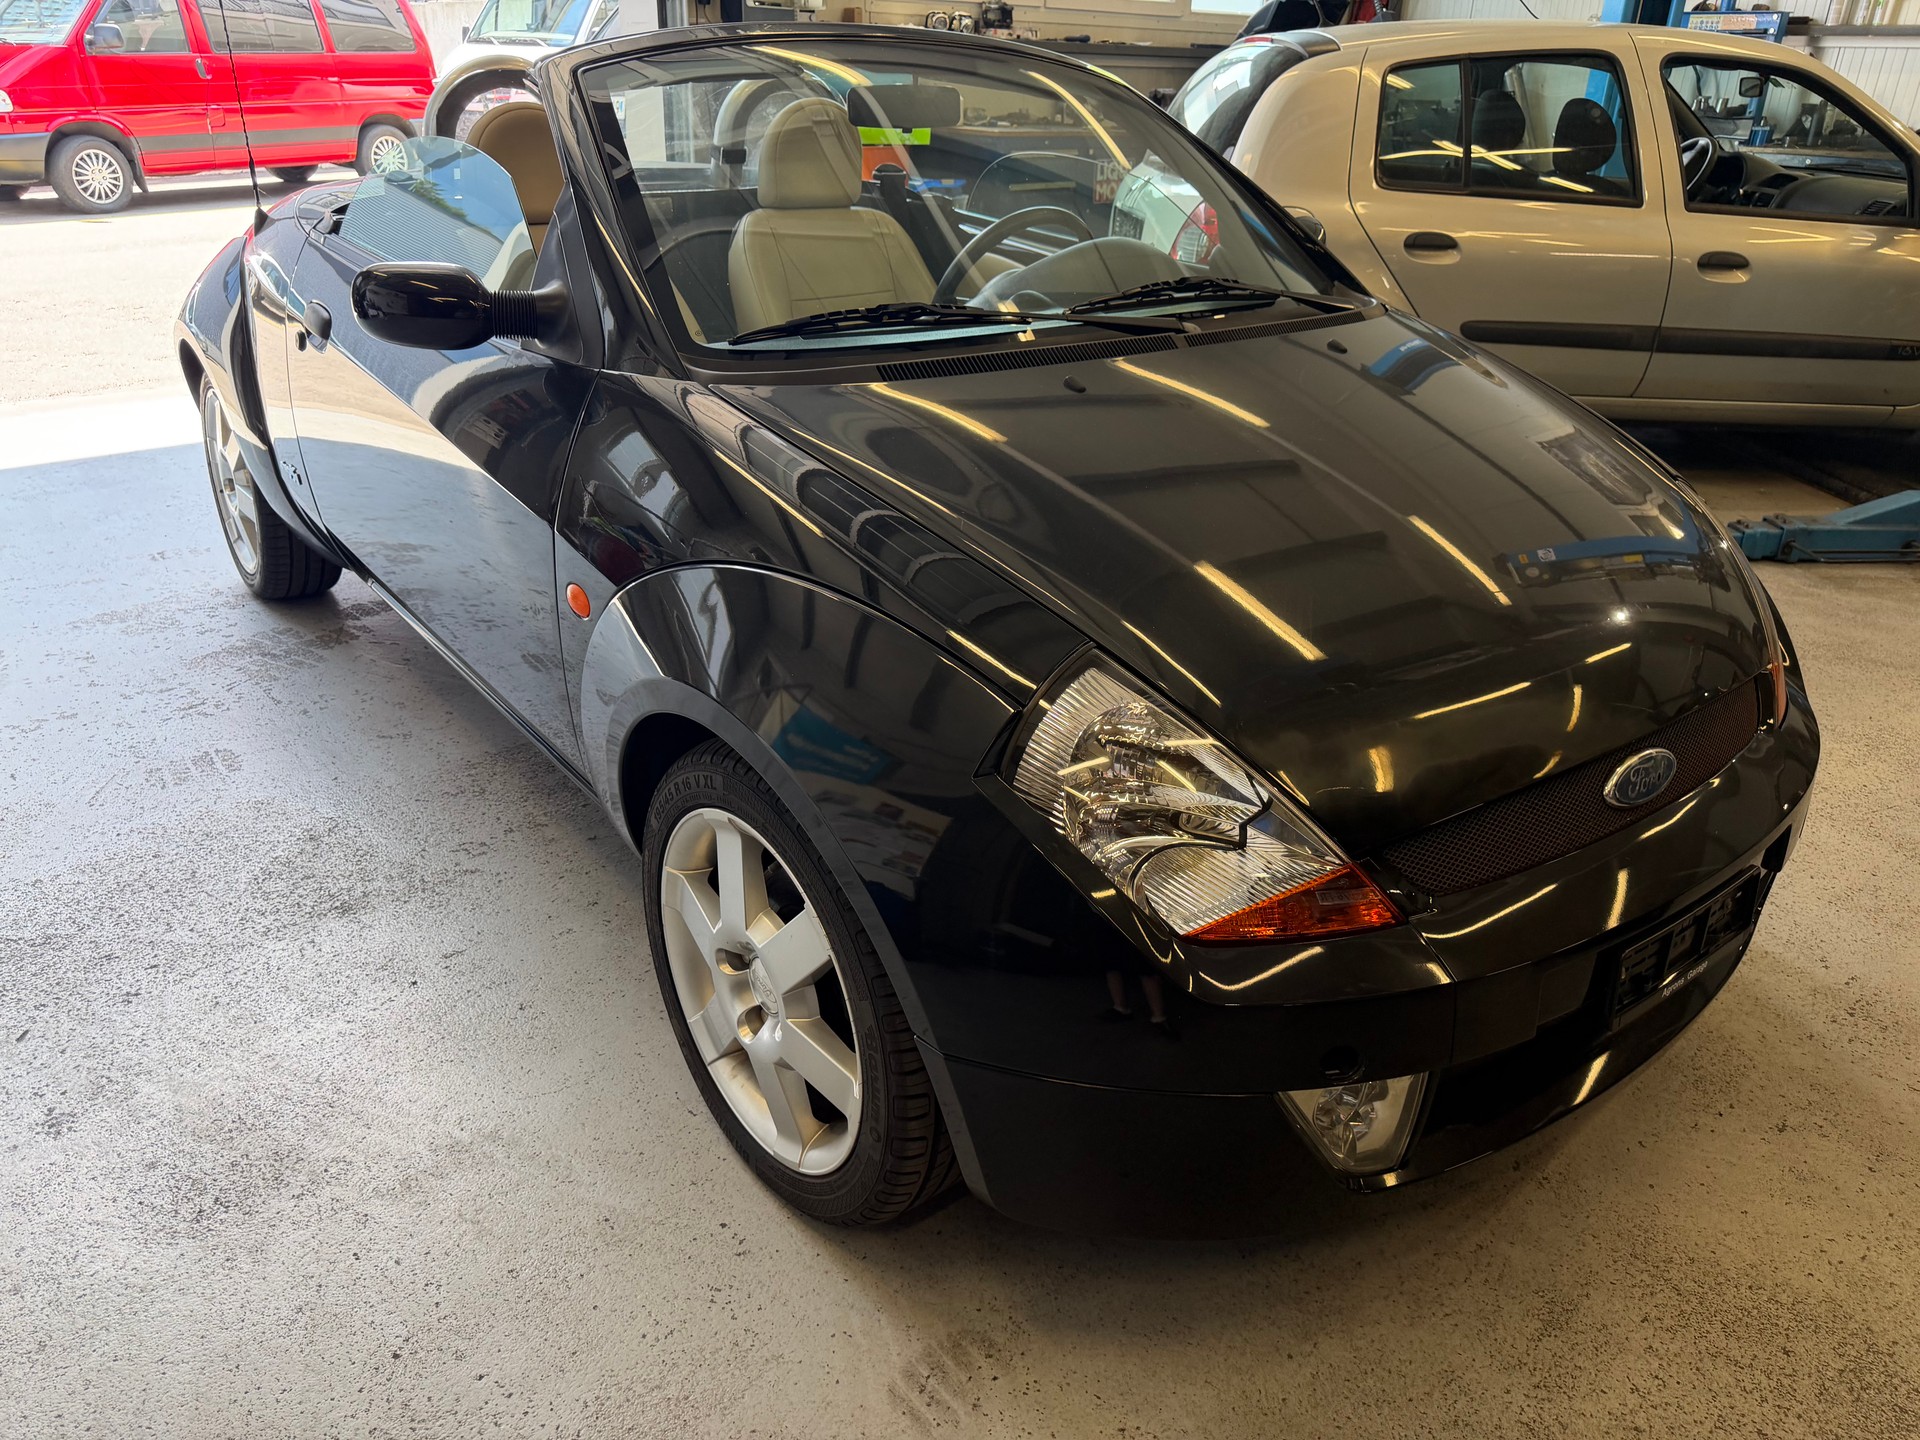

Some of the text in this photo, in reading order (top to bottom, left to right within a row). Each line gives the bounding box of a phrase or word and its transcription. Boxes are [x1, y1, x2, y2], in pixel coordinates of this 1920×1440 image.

[1096, 182, 1118, 201] MO
[1628, 759, 1667, 798] Ford
[654, 788, 675, 823] 195/45
[674, 782, 682, 796] R
[682, 775, 692, 791] 16
[693, 774, 701, 788] V
[702, 774, 717, 791] XL
[1687, 960, 1708, 980] Garage
